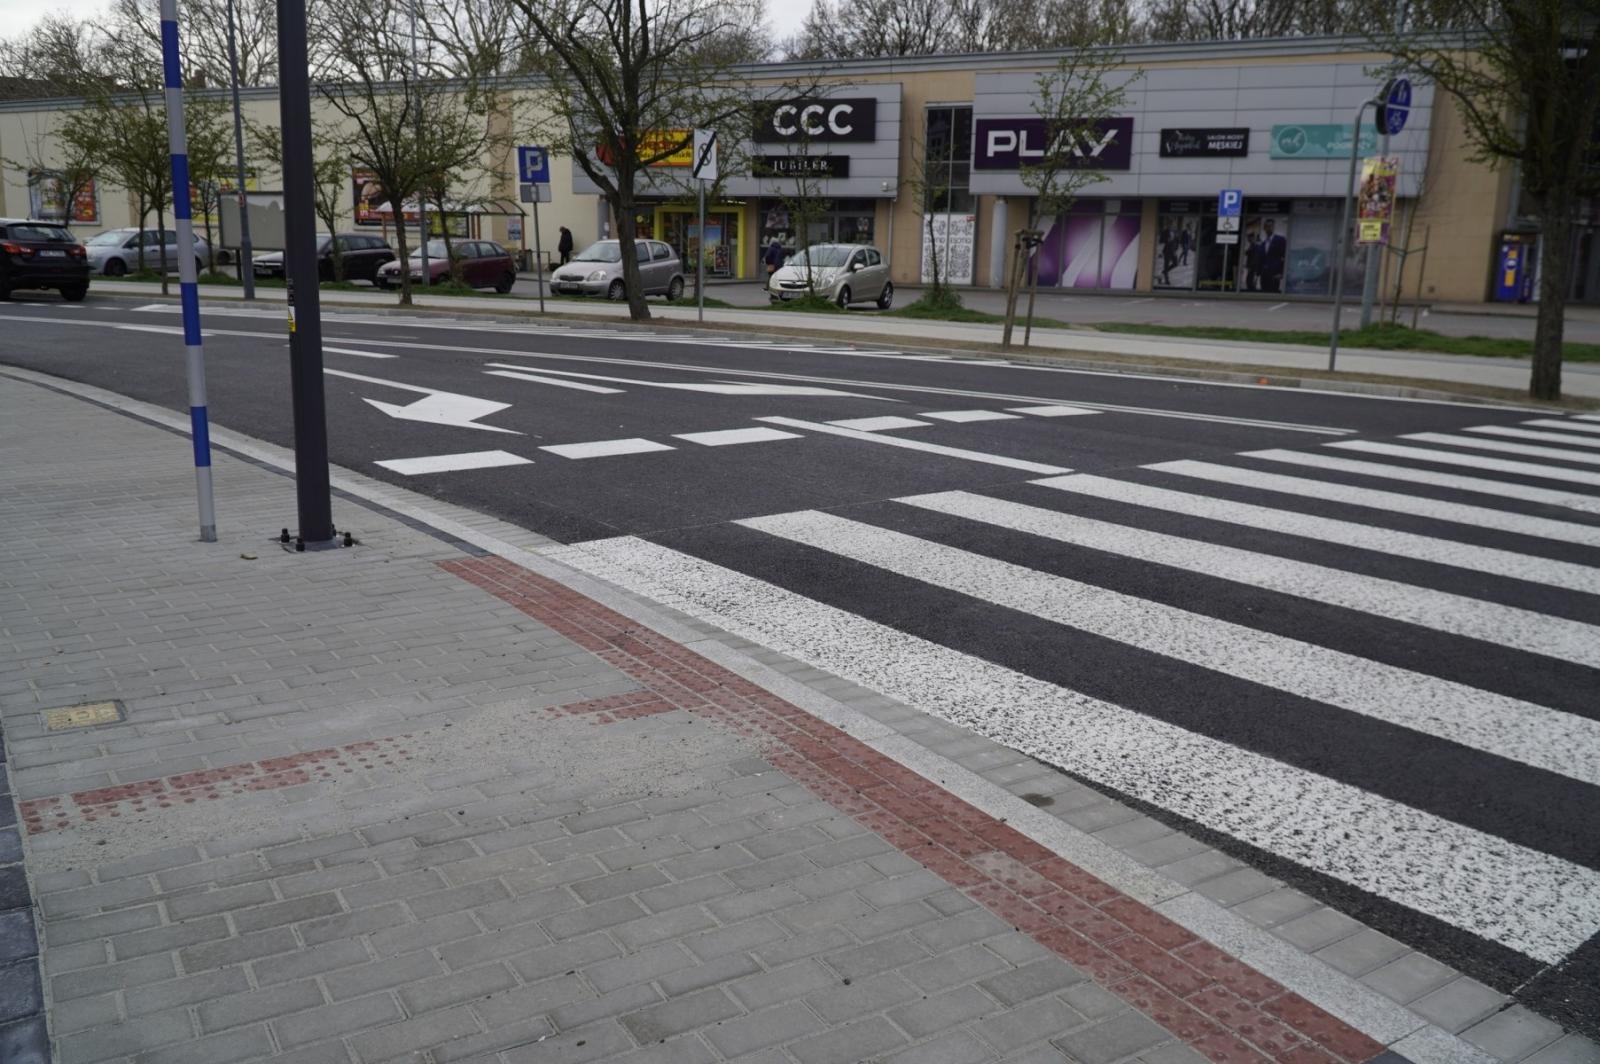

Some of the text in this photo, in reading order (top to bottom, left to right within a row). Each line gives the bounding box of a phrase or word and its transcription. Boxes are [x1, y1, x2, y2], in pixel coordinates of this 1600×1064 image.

[772, 103, 854, 135] CCC
[986, 128, 1119, 158] PLAY
[1207, 141, 1242, 151] MĘSKIEJ
[525, 150, 543, 179] P
[1224, 191, 1238, 209] P
